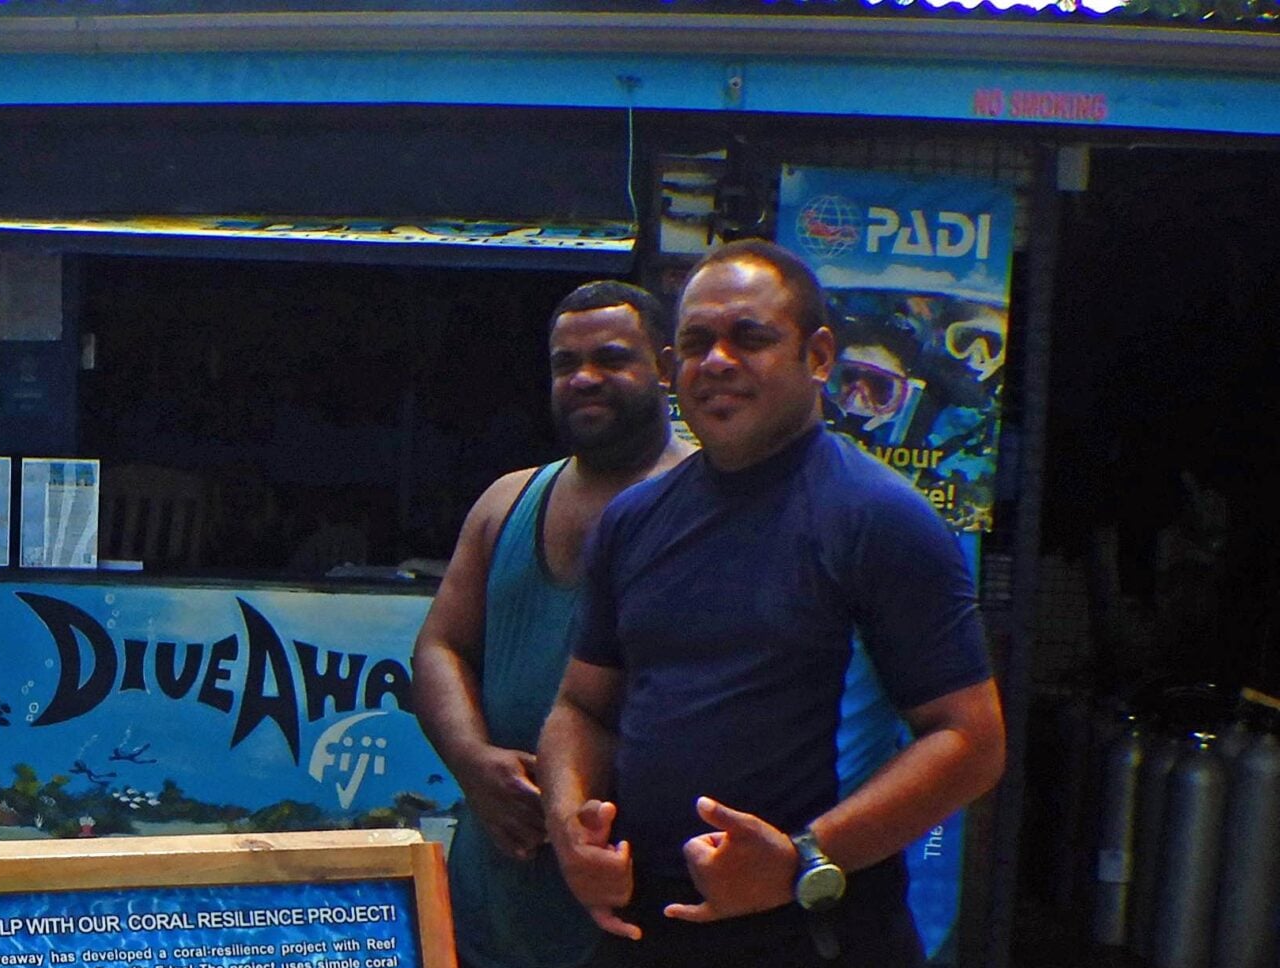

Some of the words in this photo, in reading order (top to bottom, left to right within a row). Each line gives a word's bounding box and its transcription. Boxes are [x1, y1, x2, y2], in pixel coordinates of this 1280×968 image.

[973, 87, 1003, 117] NO
[1010, 90, 1107, 121] SMOKING
[866, 206, 991, 260] PADI
[26, 917, 74, 934] WITH
[78, 915, 120, 932] OUR
[127, 913, 194, 930] CORAL
[197, 909, 304, 928] RESILIENCE
[307, 906, 396, 924] PROJECT!
[51, 950, 75, 962] has
[82, 947, 151, 964] developed
[158, 949, 166, 958] a
[173, 942, 274, 958] coral-resilience
[281, 940, 326, 956] project
[332, 939, 360, 952] with
[366, 938, 396, 950] Reef
[365, 957, 398, 968] coral
